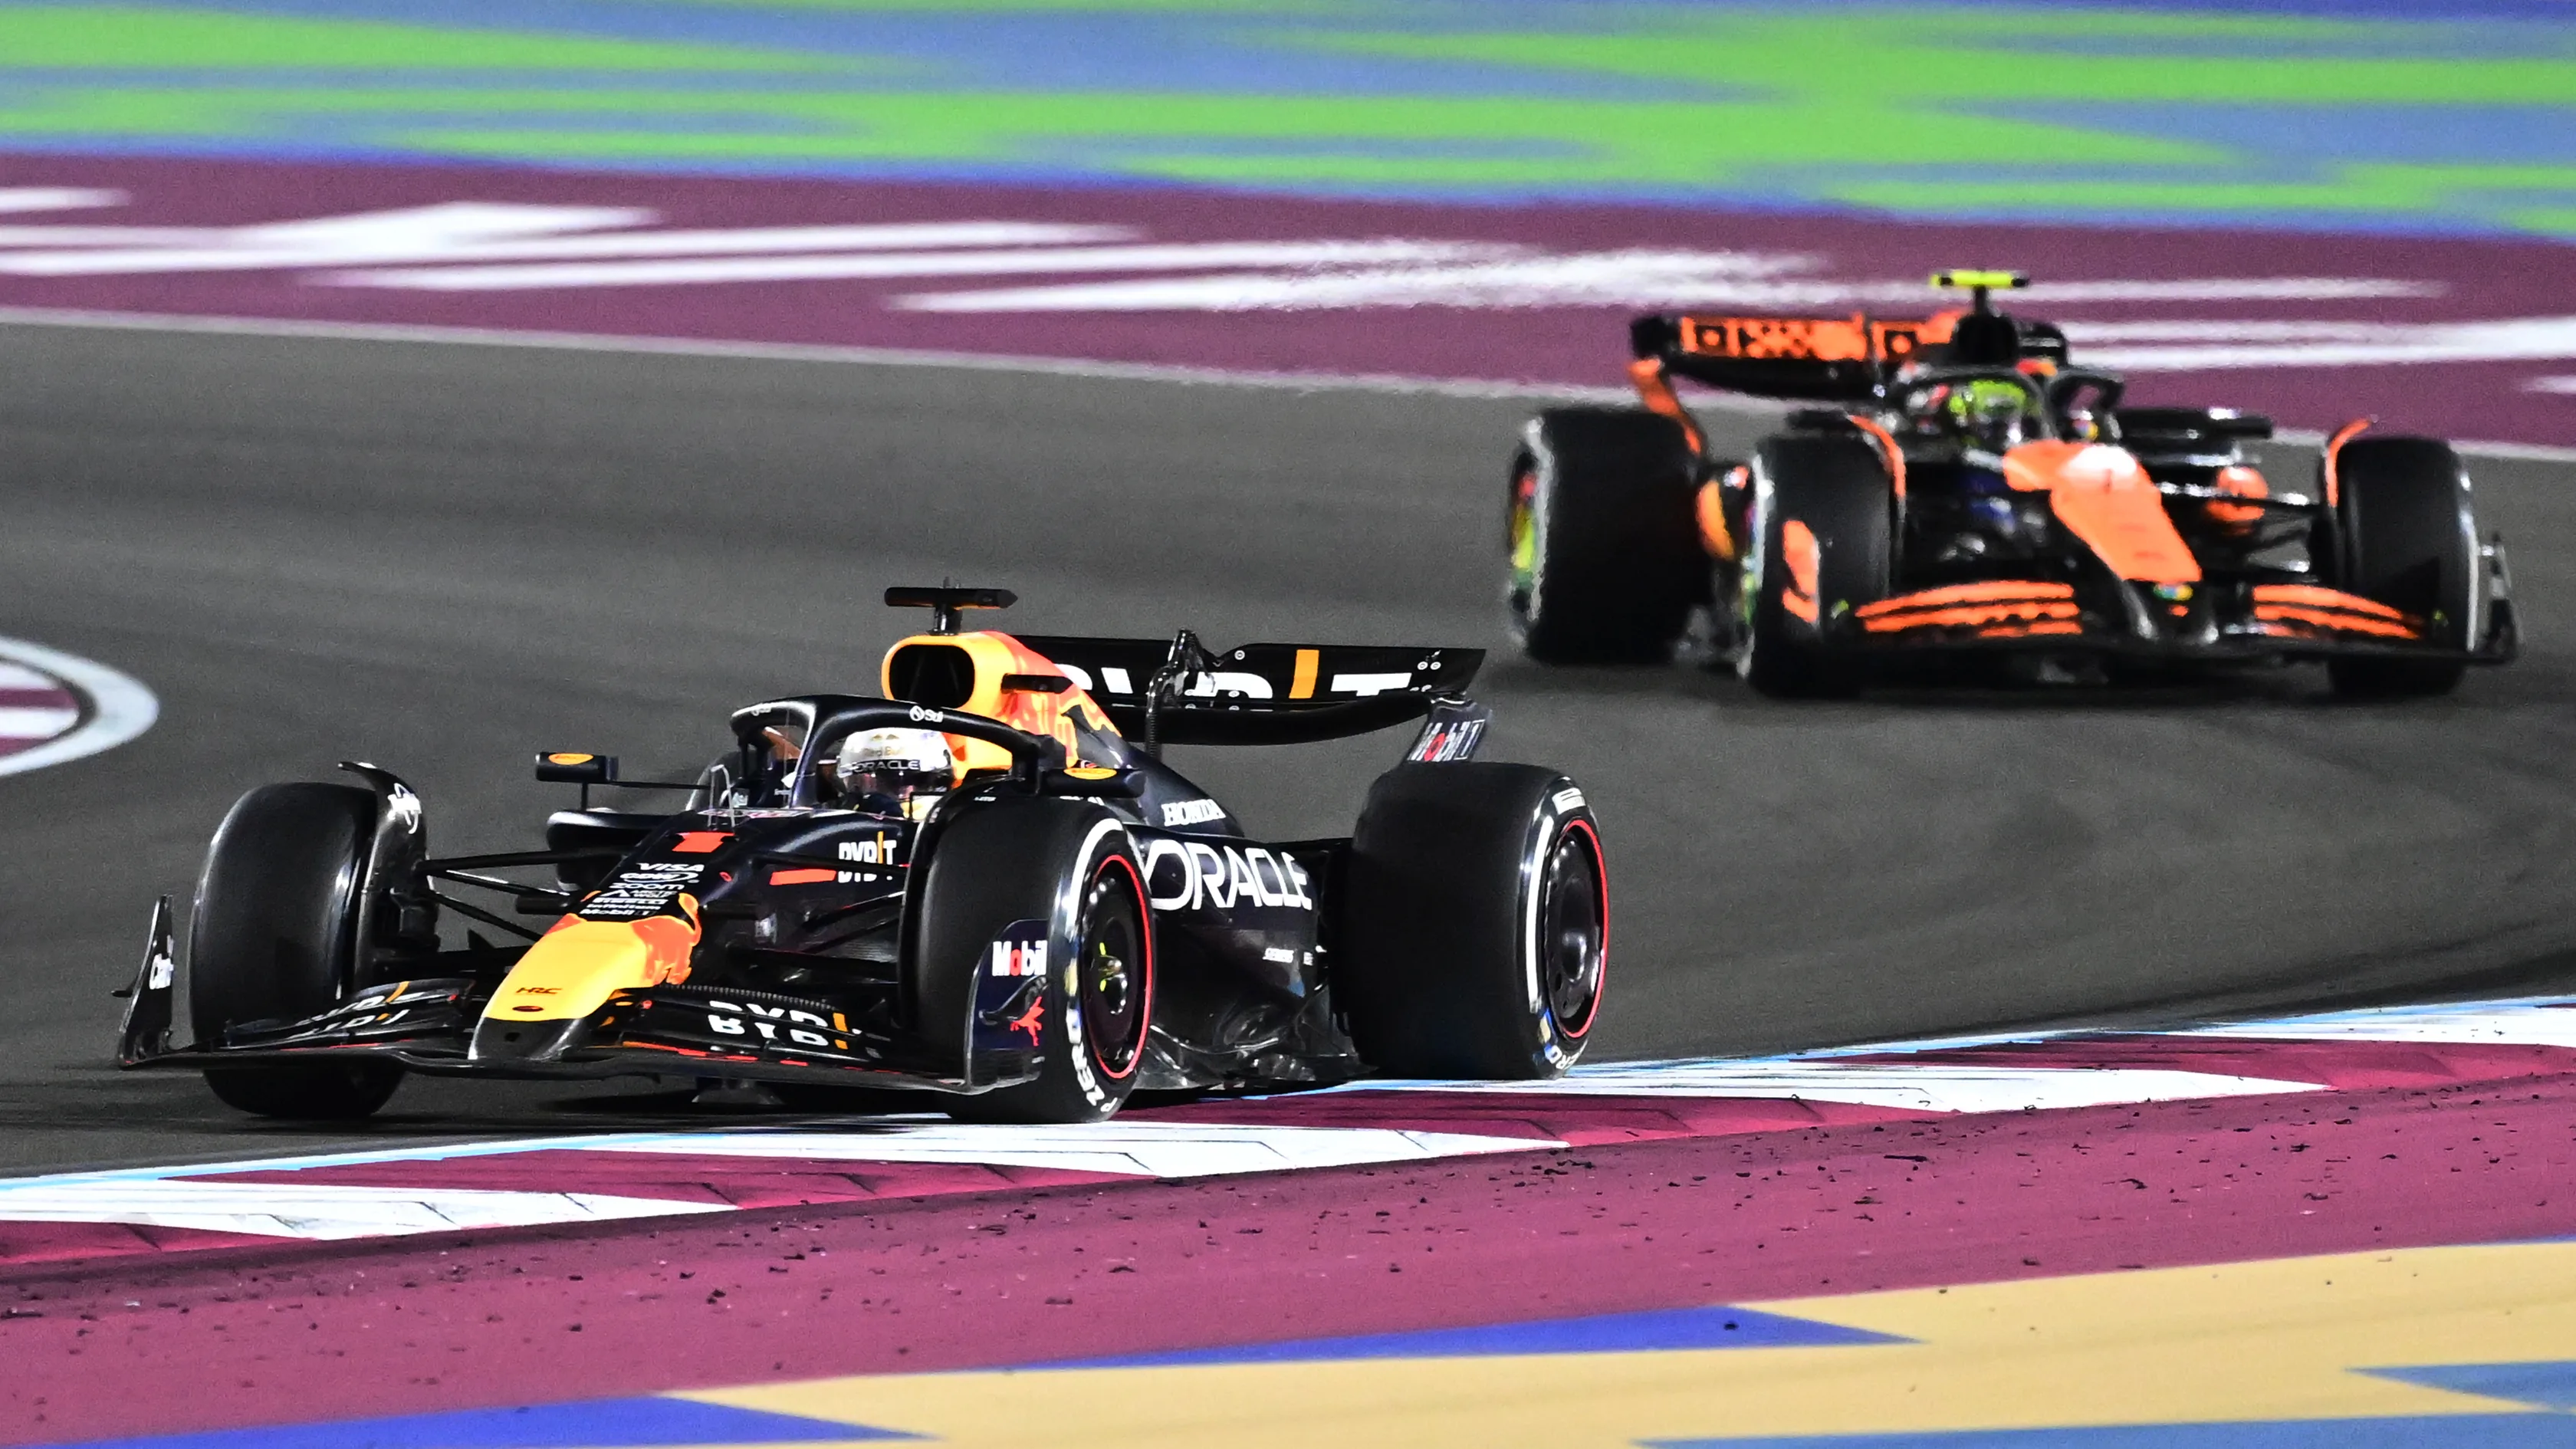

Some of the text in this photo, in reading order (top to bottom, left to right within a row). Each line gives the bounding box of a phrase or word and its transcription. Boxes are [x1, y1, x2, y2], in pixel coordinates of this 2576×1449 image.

[853, 760, 919, 773] ORACLE
[1161, 799, 1227, 826] HONDA
[636, 863, 705, 872] VISA
[1145, 840, 1313, 910] ORACLE
[992, 940, 1048, 977] Mobil
[708, 1000, 863, 1050] BYBI
